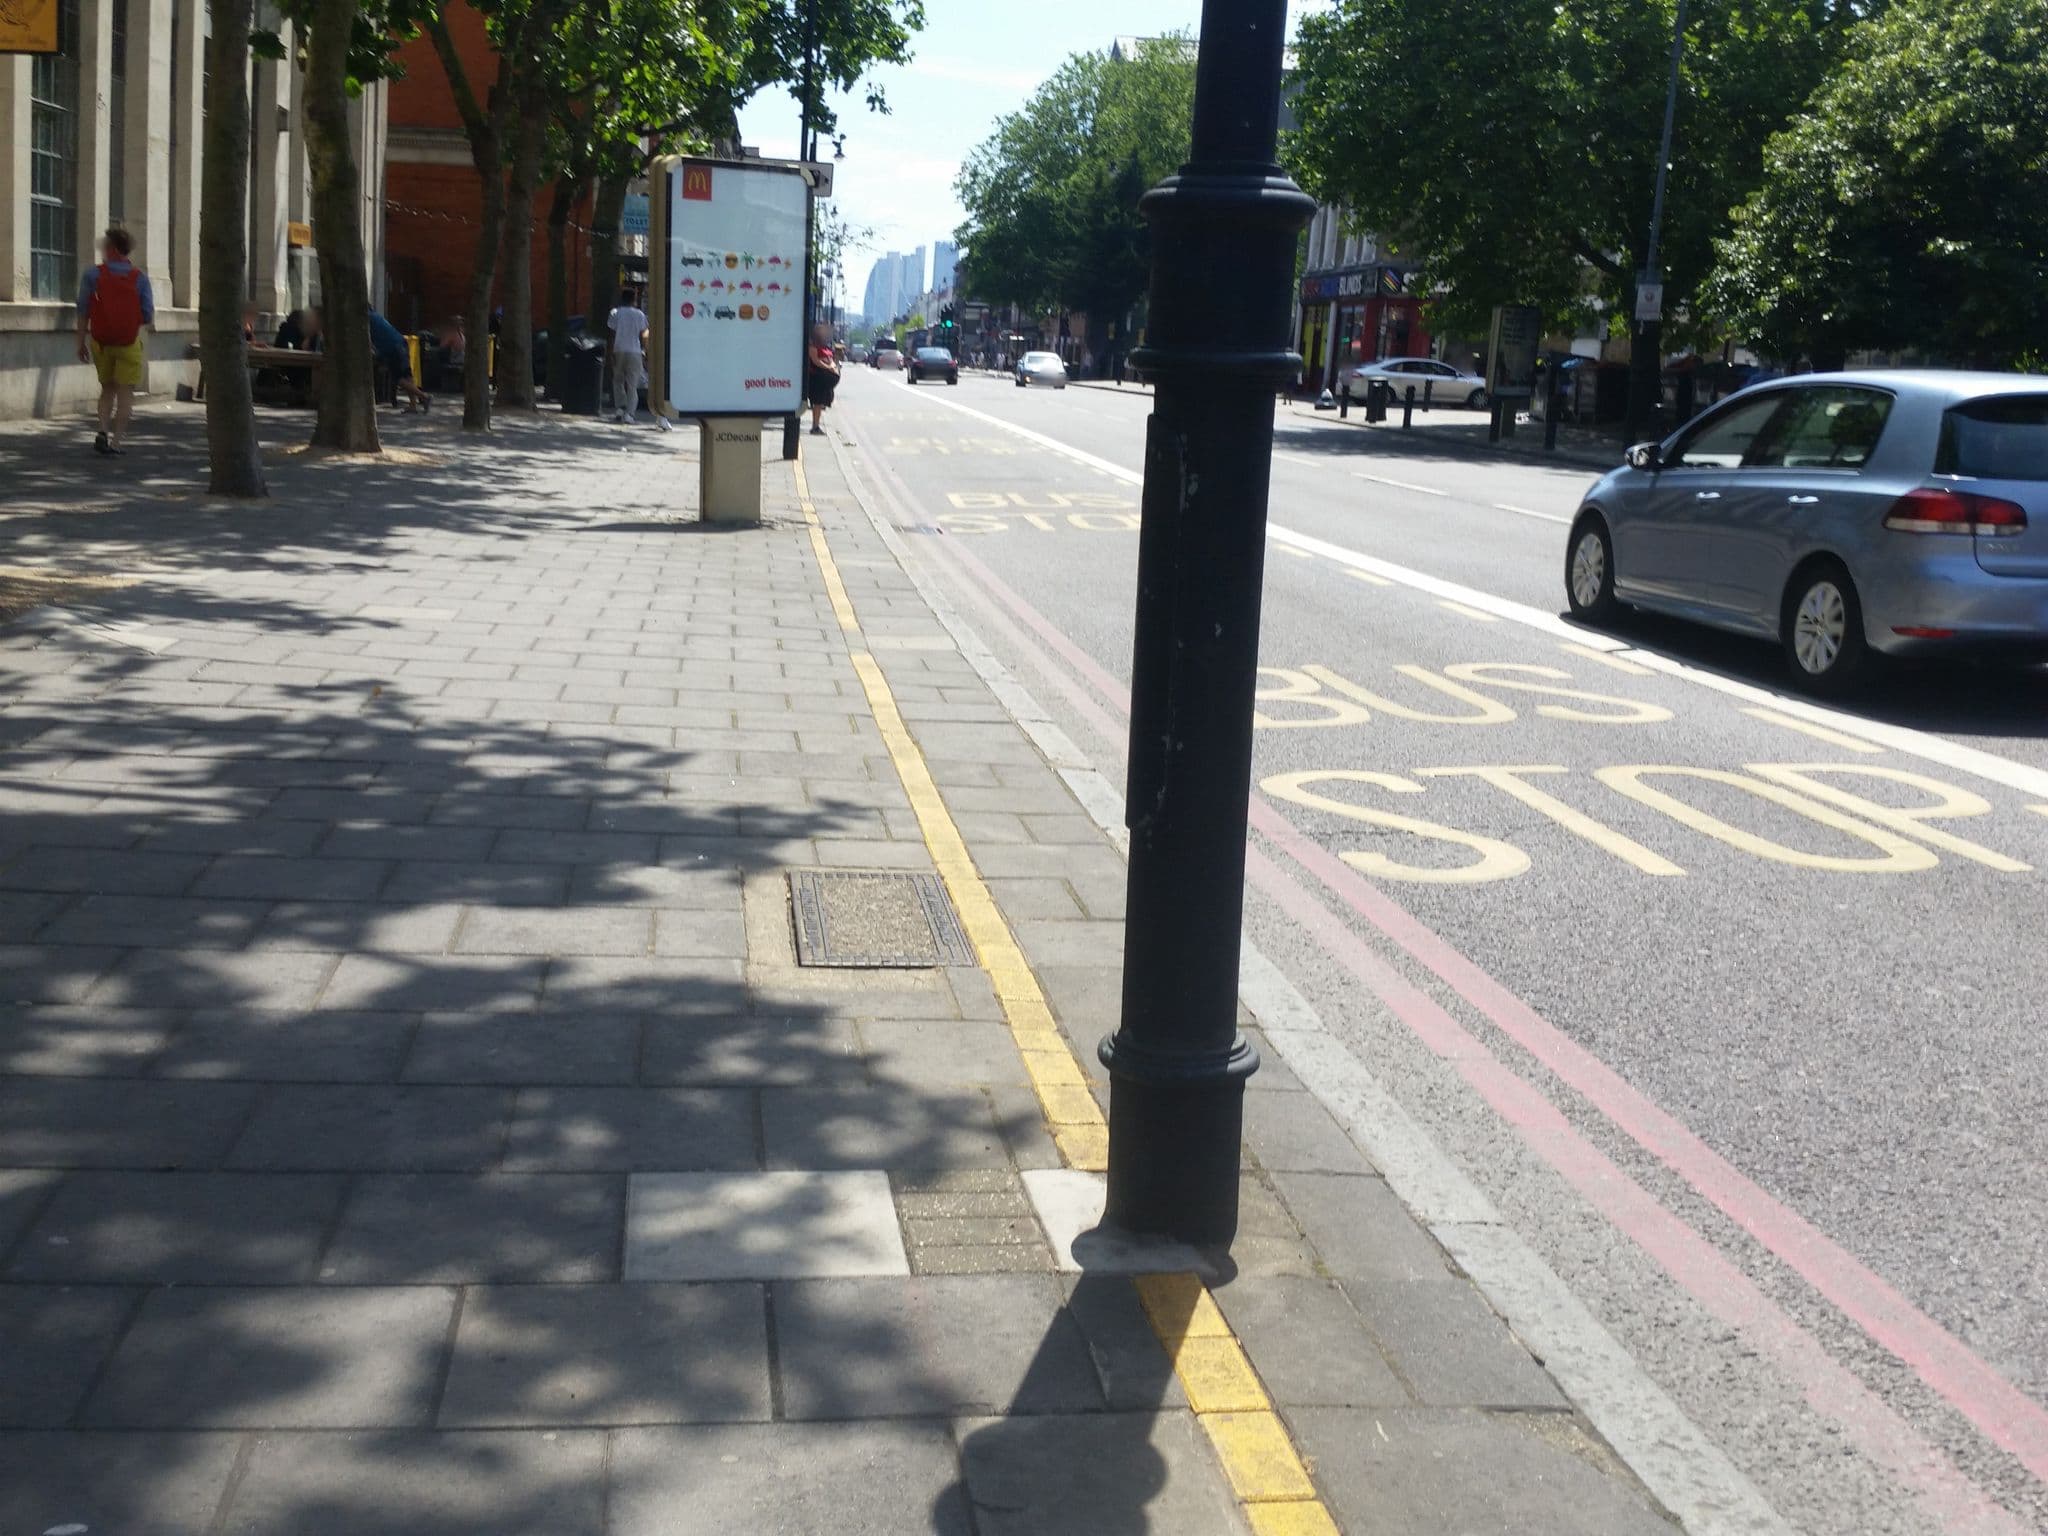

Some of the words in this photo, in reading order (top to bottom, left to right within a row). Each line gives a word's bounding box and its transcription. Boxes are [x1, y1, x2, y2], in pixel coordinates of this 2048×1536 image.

[744, 377, 766, 390] good
[768, 376, 791, 388] times
[945, 491, 1137, 509] BUS
[935, 512, 1141, 534] STO
[1253, 663, 1676, 729] BUS
[1258, 763, 2035, 884] STOP
